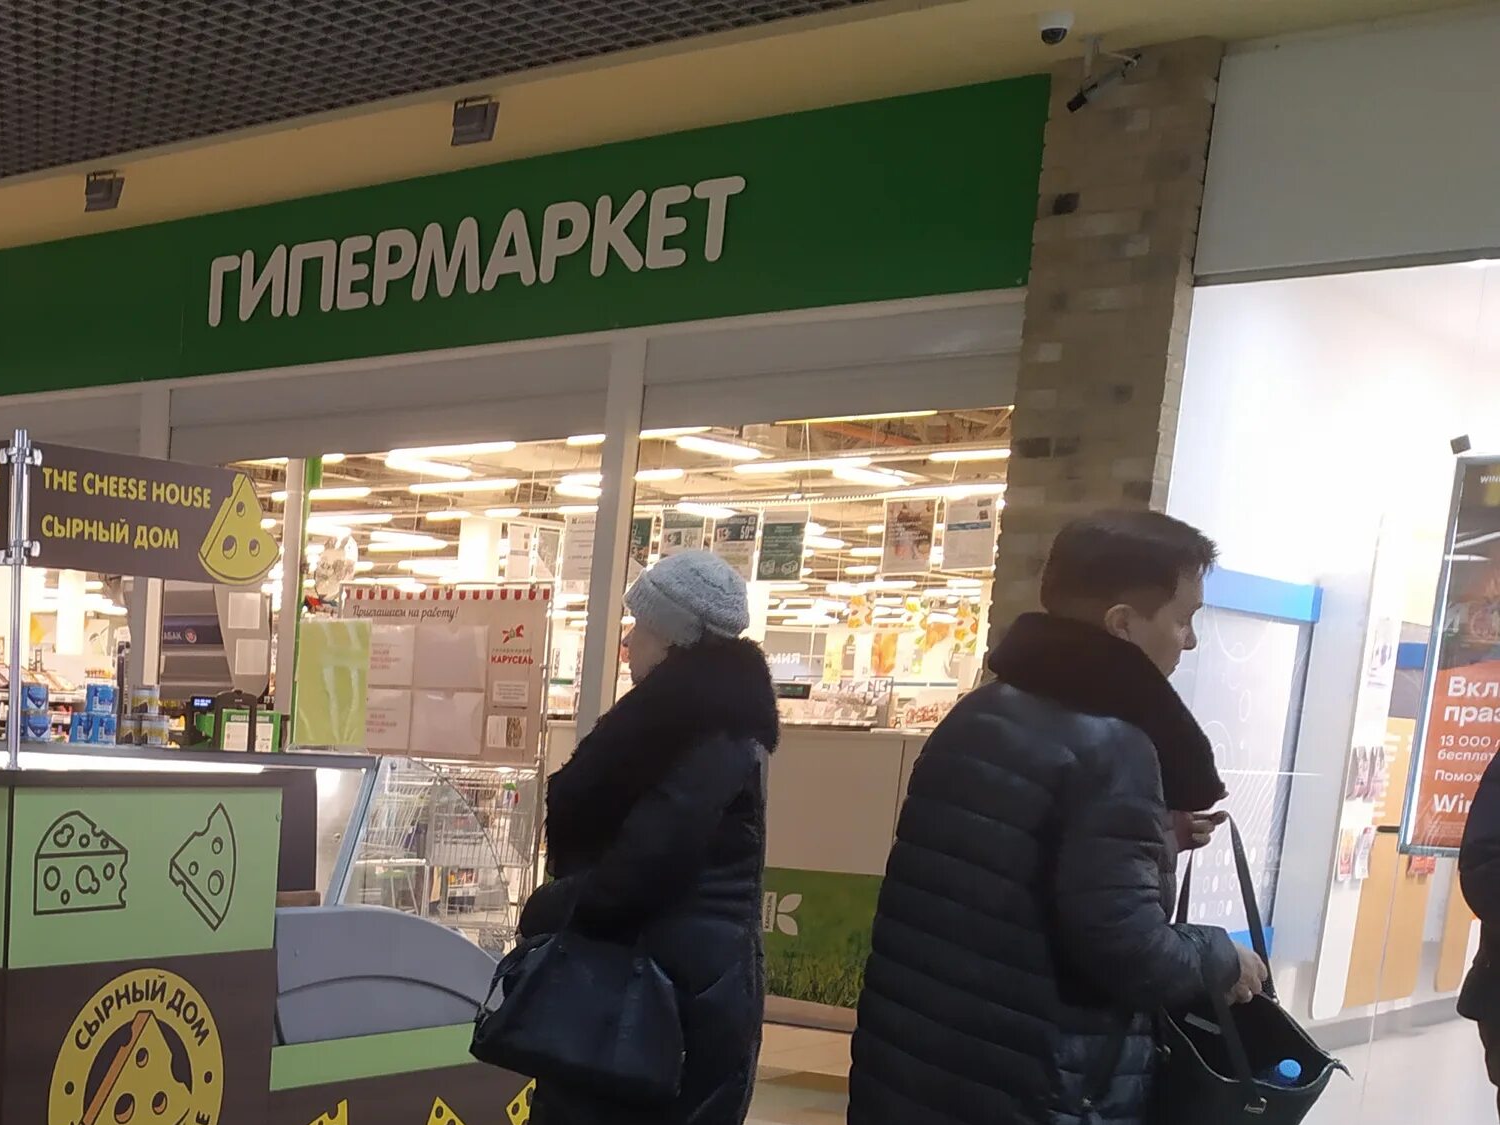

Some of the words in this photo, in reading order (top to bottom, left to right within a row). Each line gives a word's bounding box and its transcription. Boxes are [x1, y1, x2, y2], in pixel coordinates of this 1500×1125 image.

[207, 175, 746, 328] ГИПЕРМАРКЕТ
[42, 467, 77, 492] THE
[83, 472, 147, 501] CHEESE
[152, 481, 212, 509] HOUSE
[41, 514, 130, 545] СЫРНЫЙ
[133, 525, 179, 550] ДОМ
[353, 604, 406, 618] Приглашаем
[408, 608, 419, 617] на
[420, 606, 460, 622] работу!
[491, 655, 534, 665] КАРУСЕЛЬ
[1440, 734, 1454, 747] 13
[1458, 735, 1491, 748] 000
[74, 974, 168, 1050] СЫРНЫЙ
[166, 988, 210, 1047] ДОМ
